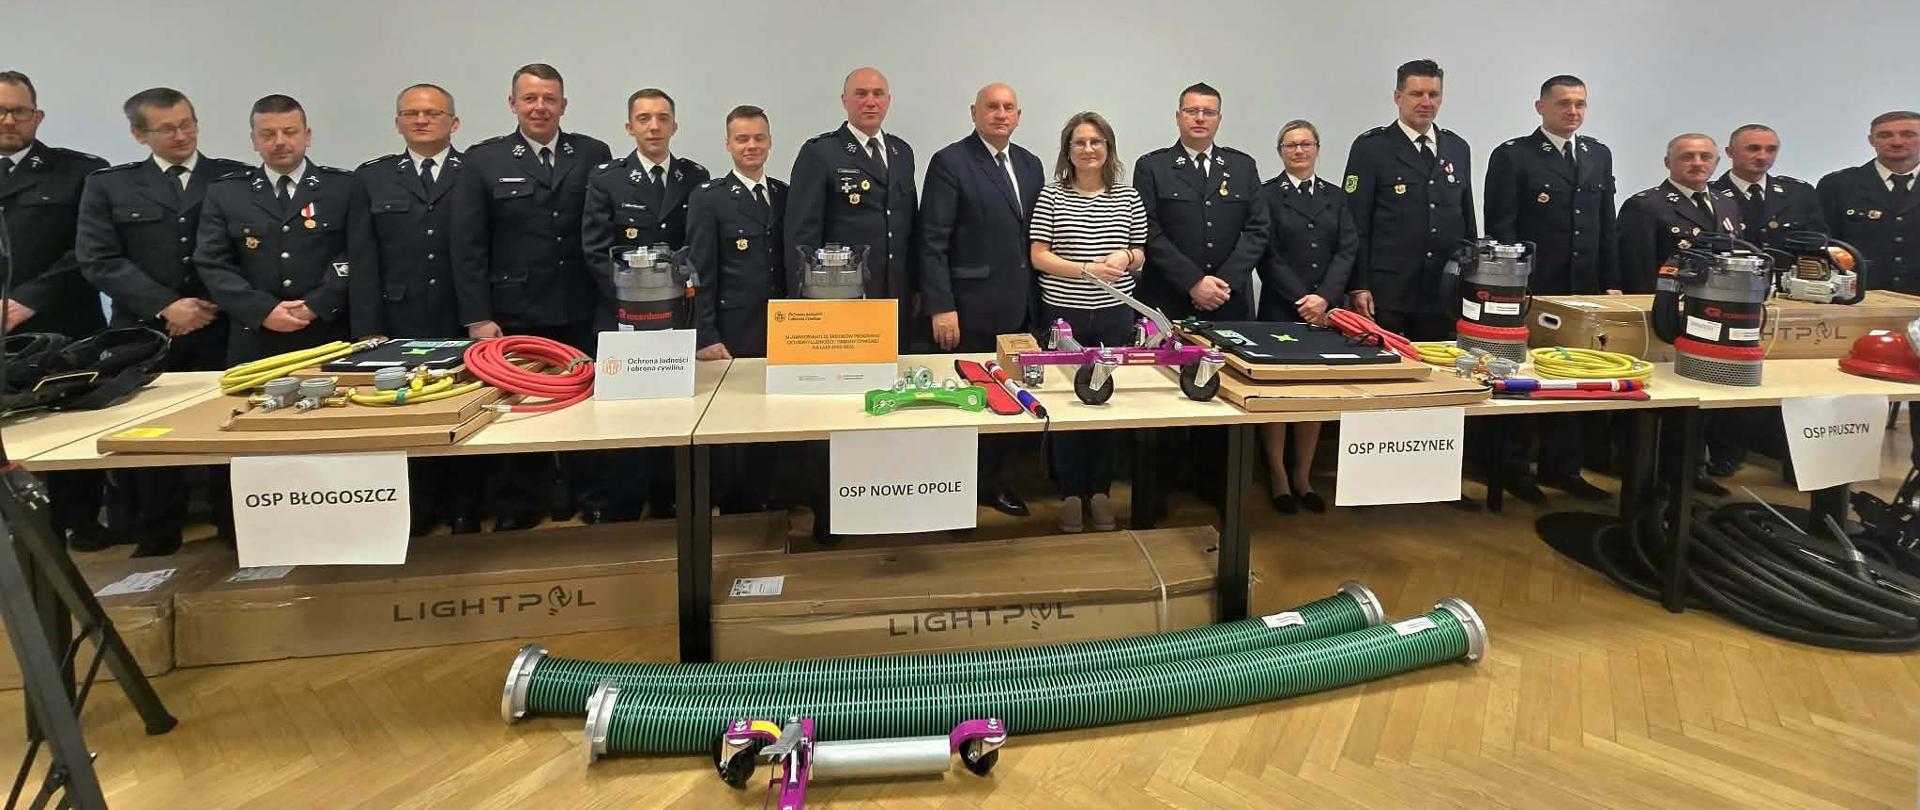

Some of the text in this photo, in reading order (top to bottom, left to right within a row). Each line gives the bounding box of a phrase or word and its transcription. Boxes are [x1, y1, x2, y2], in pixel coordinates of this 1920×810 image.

[627, 357, 658, 365] Ochrona
[657, 364, 684, 373] cywilna
[1803, 423, 1870, 439] OSP PRUSZYN
[1347, 439, 1455, 455] OSP PRUSZYNEK
[839, 481, 962, 498] OSP NOWE OPOLE
[245, 488, 397, 508] OSP BŁOGOSZCZ
